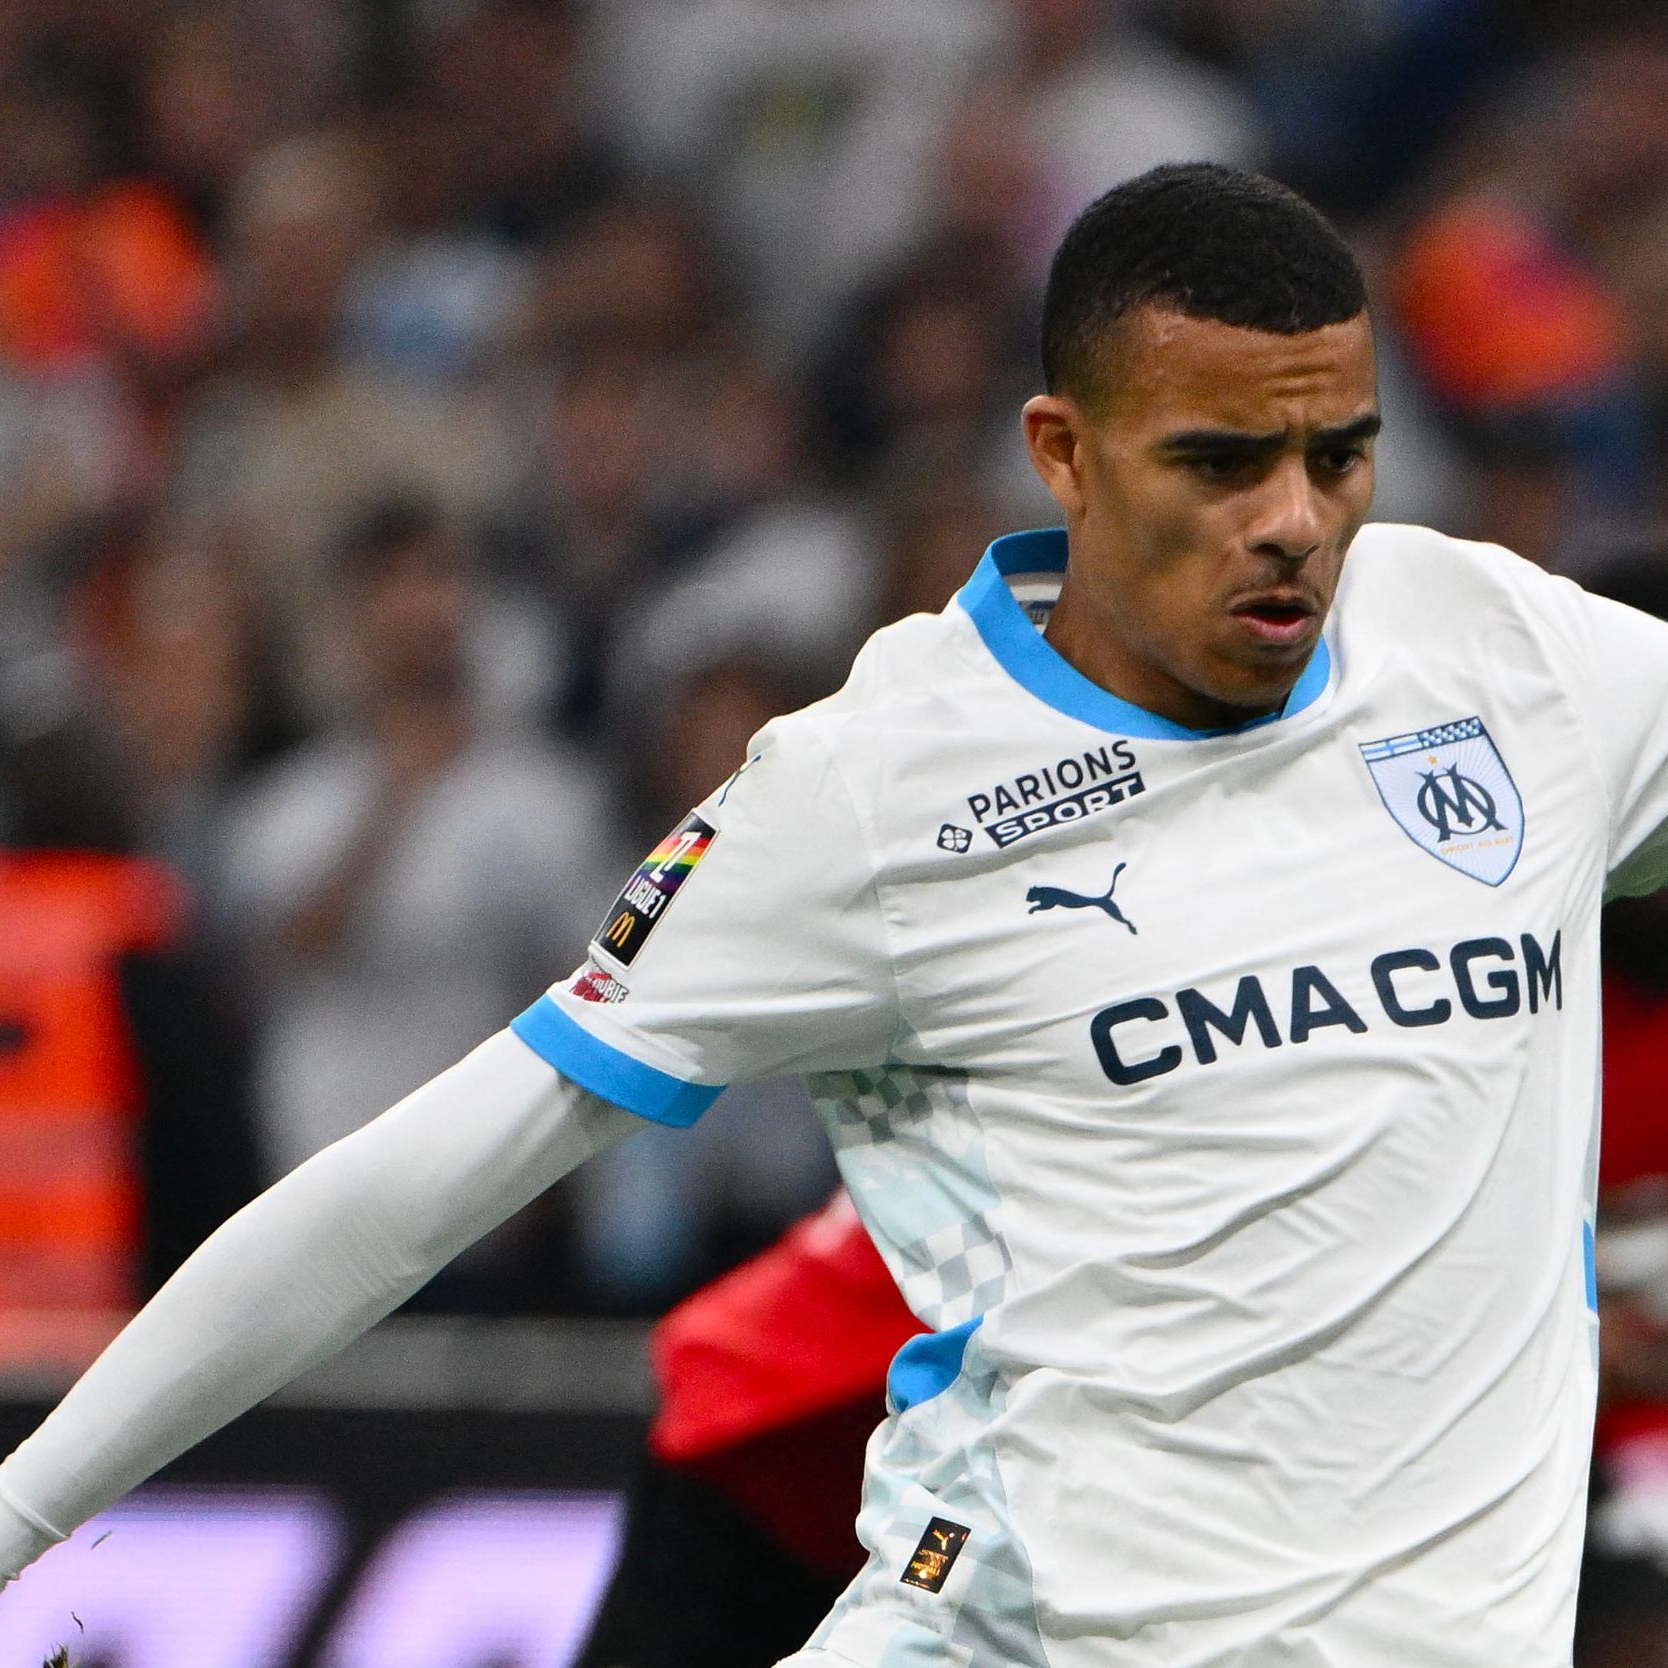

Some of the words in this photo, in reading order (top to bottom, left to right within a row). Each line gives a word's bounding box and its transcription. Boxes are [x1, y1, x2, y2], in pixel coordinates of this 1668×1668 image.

[967, 739, 1136, 823] PARIONS
[995, 777, 1139, 844] SPORT
[1090, 965, 1369, 1086] CMA
[1371, 929, 1563, 1028] CGM
